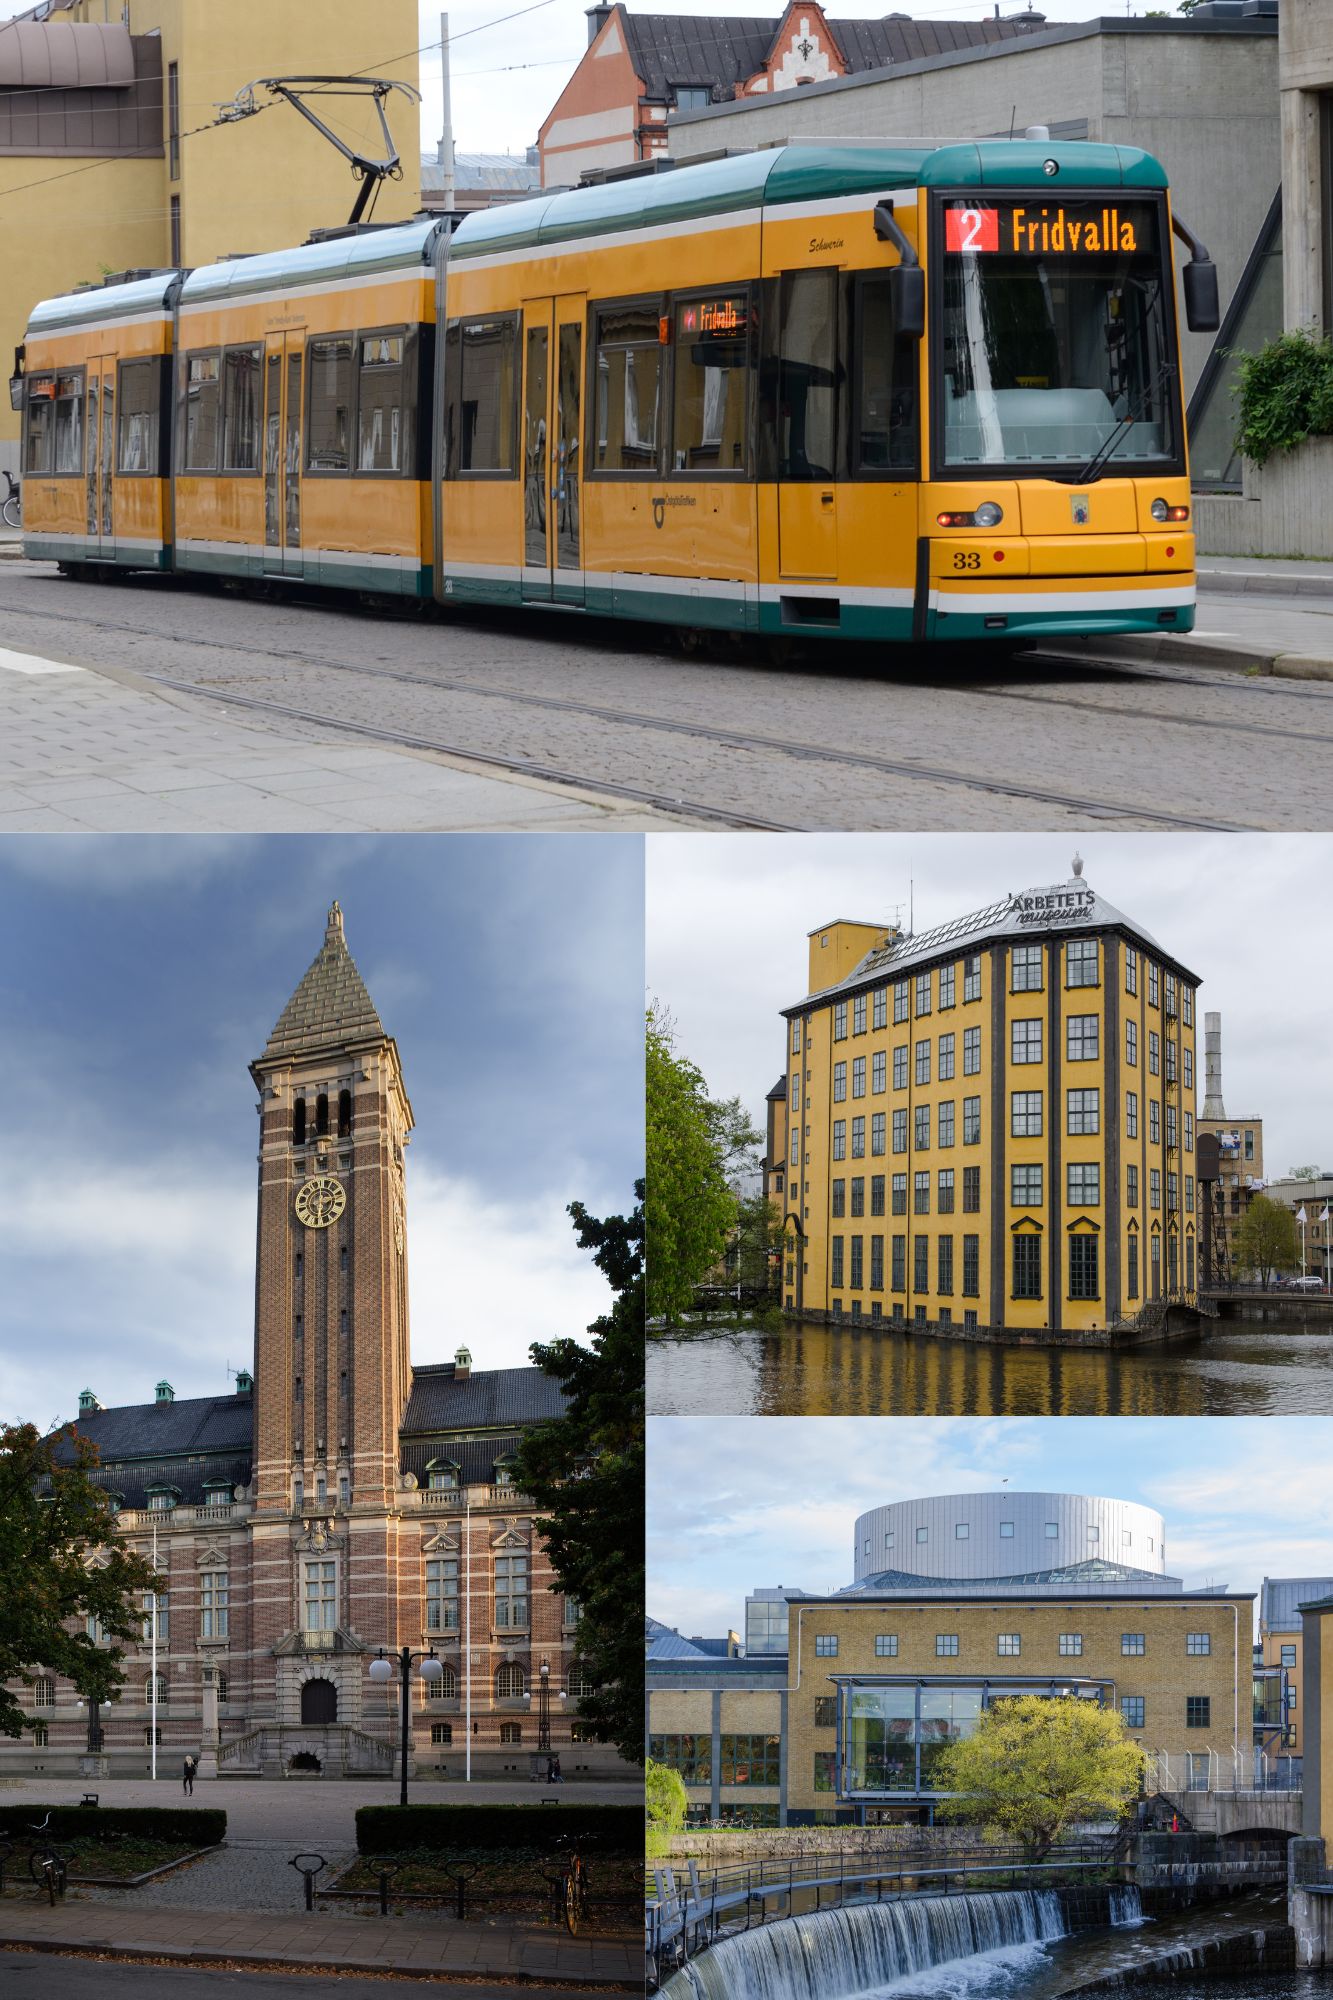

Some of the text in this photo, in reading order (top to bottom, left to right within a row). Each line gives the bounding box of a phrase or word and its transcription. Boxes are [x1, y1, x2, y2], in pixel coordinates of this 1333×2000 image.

[961, 209, 1137, 252] 2 Fridvalla
[808, 238, 845, 253] Schwerin
[953, 552, 981, 570] 33
[1010, 890, 1096, 913] ARBETETS
[1016, 906, 1092, 923] museum
